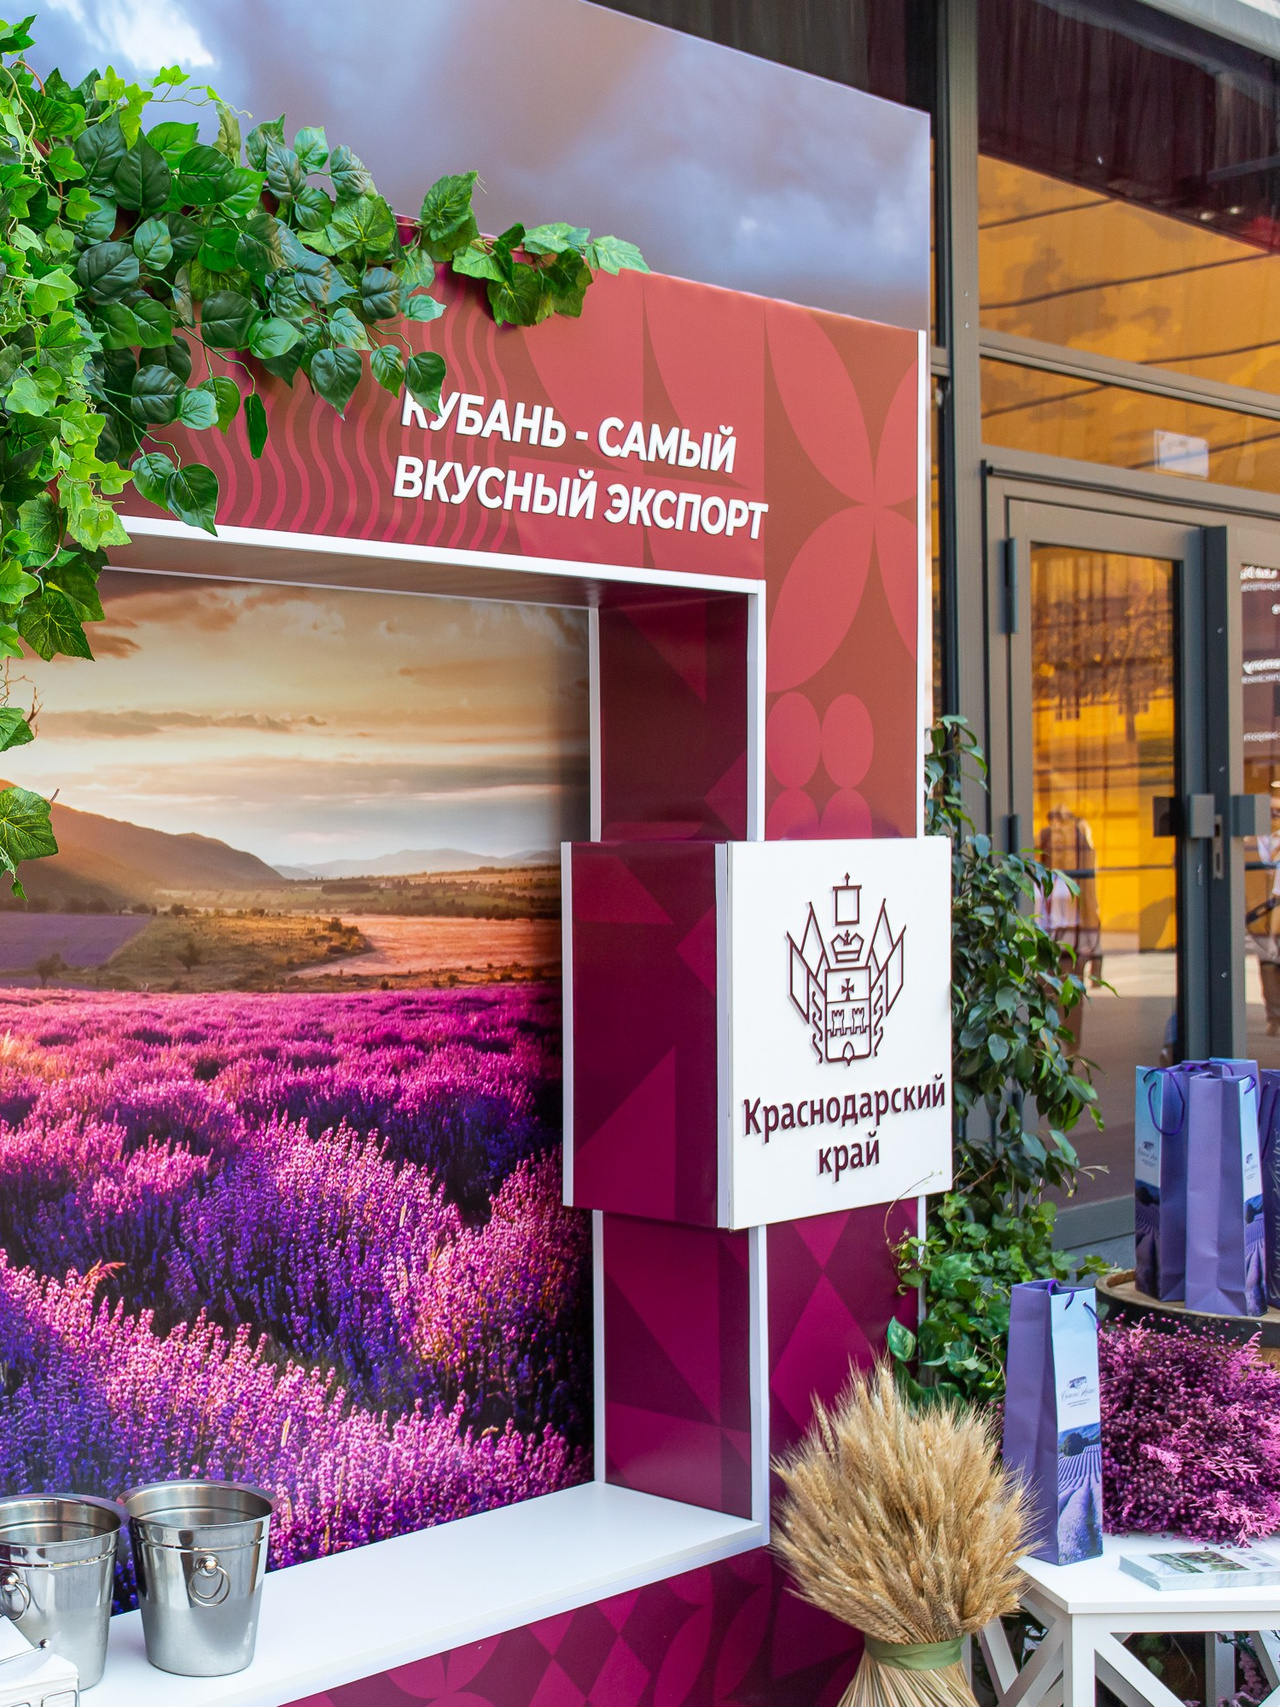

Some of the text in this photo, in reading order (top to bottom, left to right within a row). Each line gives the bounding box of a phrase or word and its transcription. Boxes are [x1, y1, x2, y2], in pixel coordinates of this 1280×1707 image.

[401, 388, 737, 474] КУБАНЬ - САМЫЙ
[393, 455, 769, 540] ВКУСНЫЙ ЭКСПОРТ
[743, 1073, 946, 1145] Краснодарский
[817, 1130, 881, 1183] край
